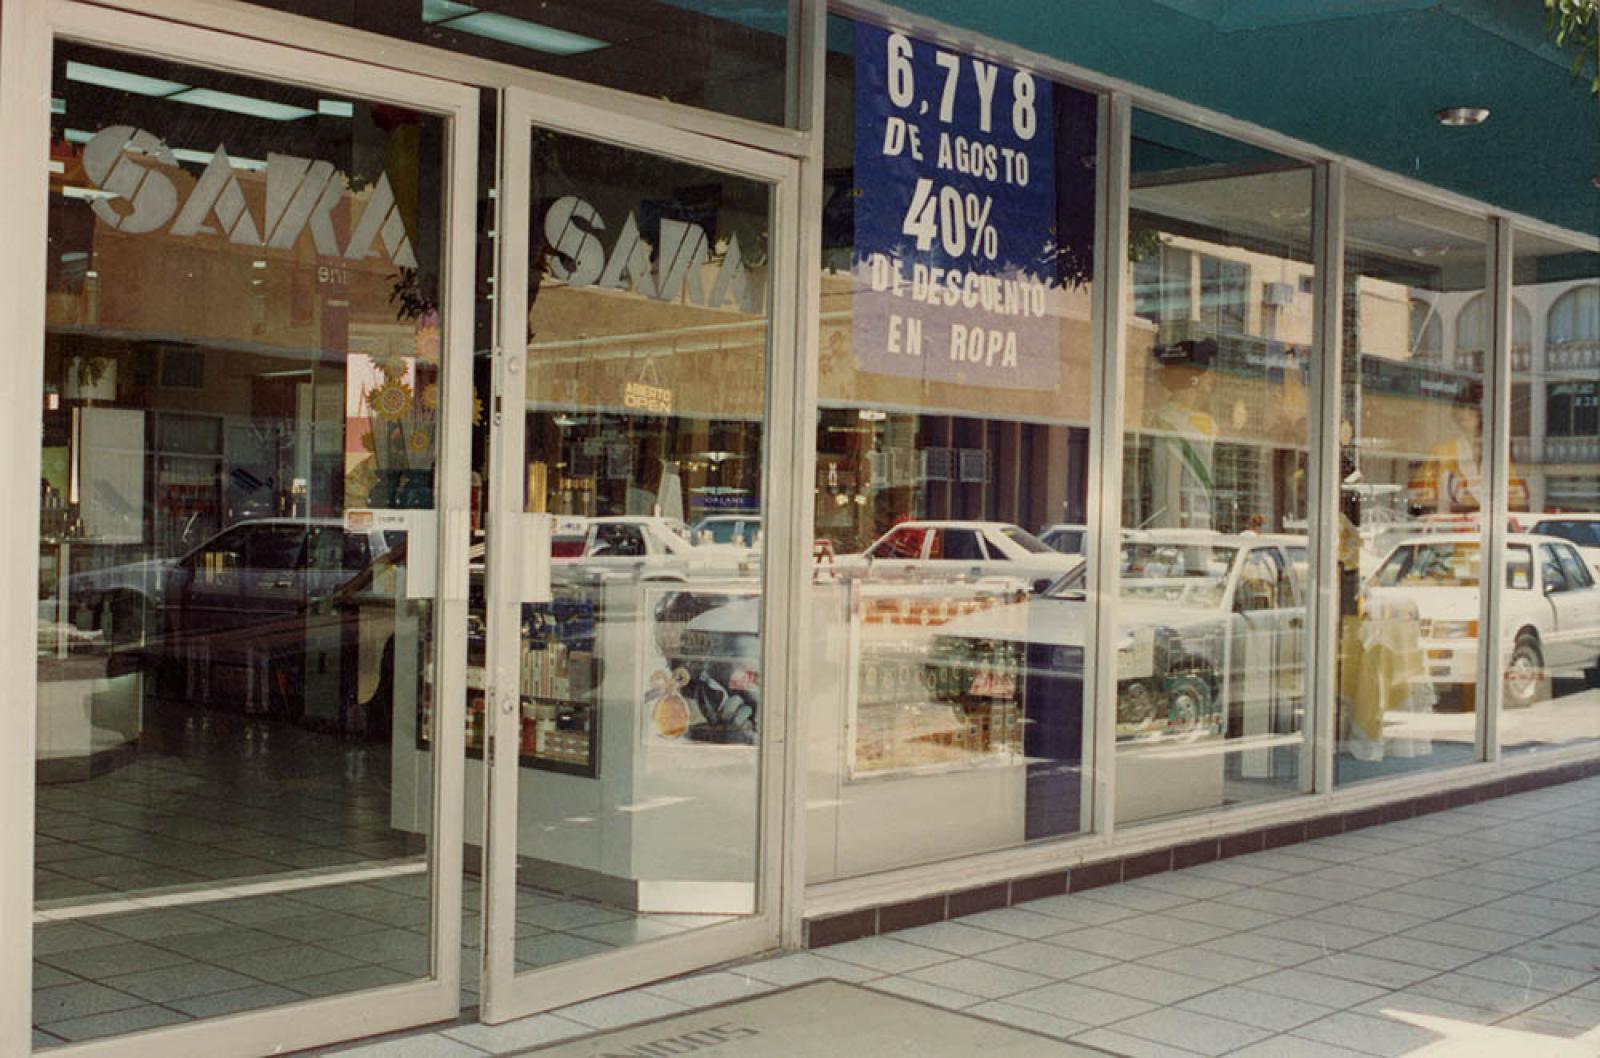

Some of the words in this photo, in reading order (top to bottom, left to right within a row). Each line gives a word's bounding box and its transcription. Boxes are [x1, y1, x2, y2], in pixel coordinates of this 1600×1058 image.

[972, 60, 998, 133] Y
[1012, 71, 1037, 140] 8
[883, 116, 924, 161] DE
[937, 132, 1030, 187] AGOSTO
[82, 125, 419, 269] SARA
[903, 178, 998, 260] 40%
[544, 194, 764, 316] SARA
[871, 252, 904, 296] DE
[911, 263, 1046, 318] DESCUENTO
[887, 314, 922, 355] EN
[950, 322, 1018, 367] ROPA
[624, 395, 672, 415] OPEN
